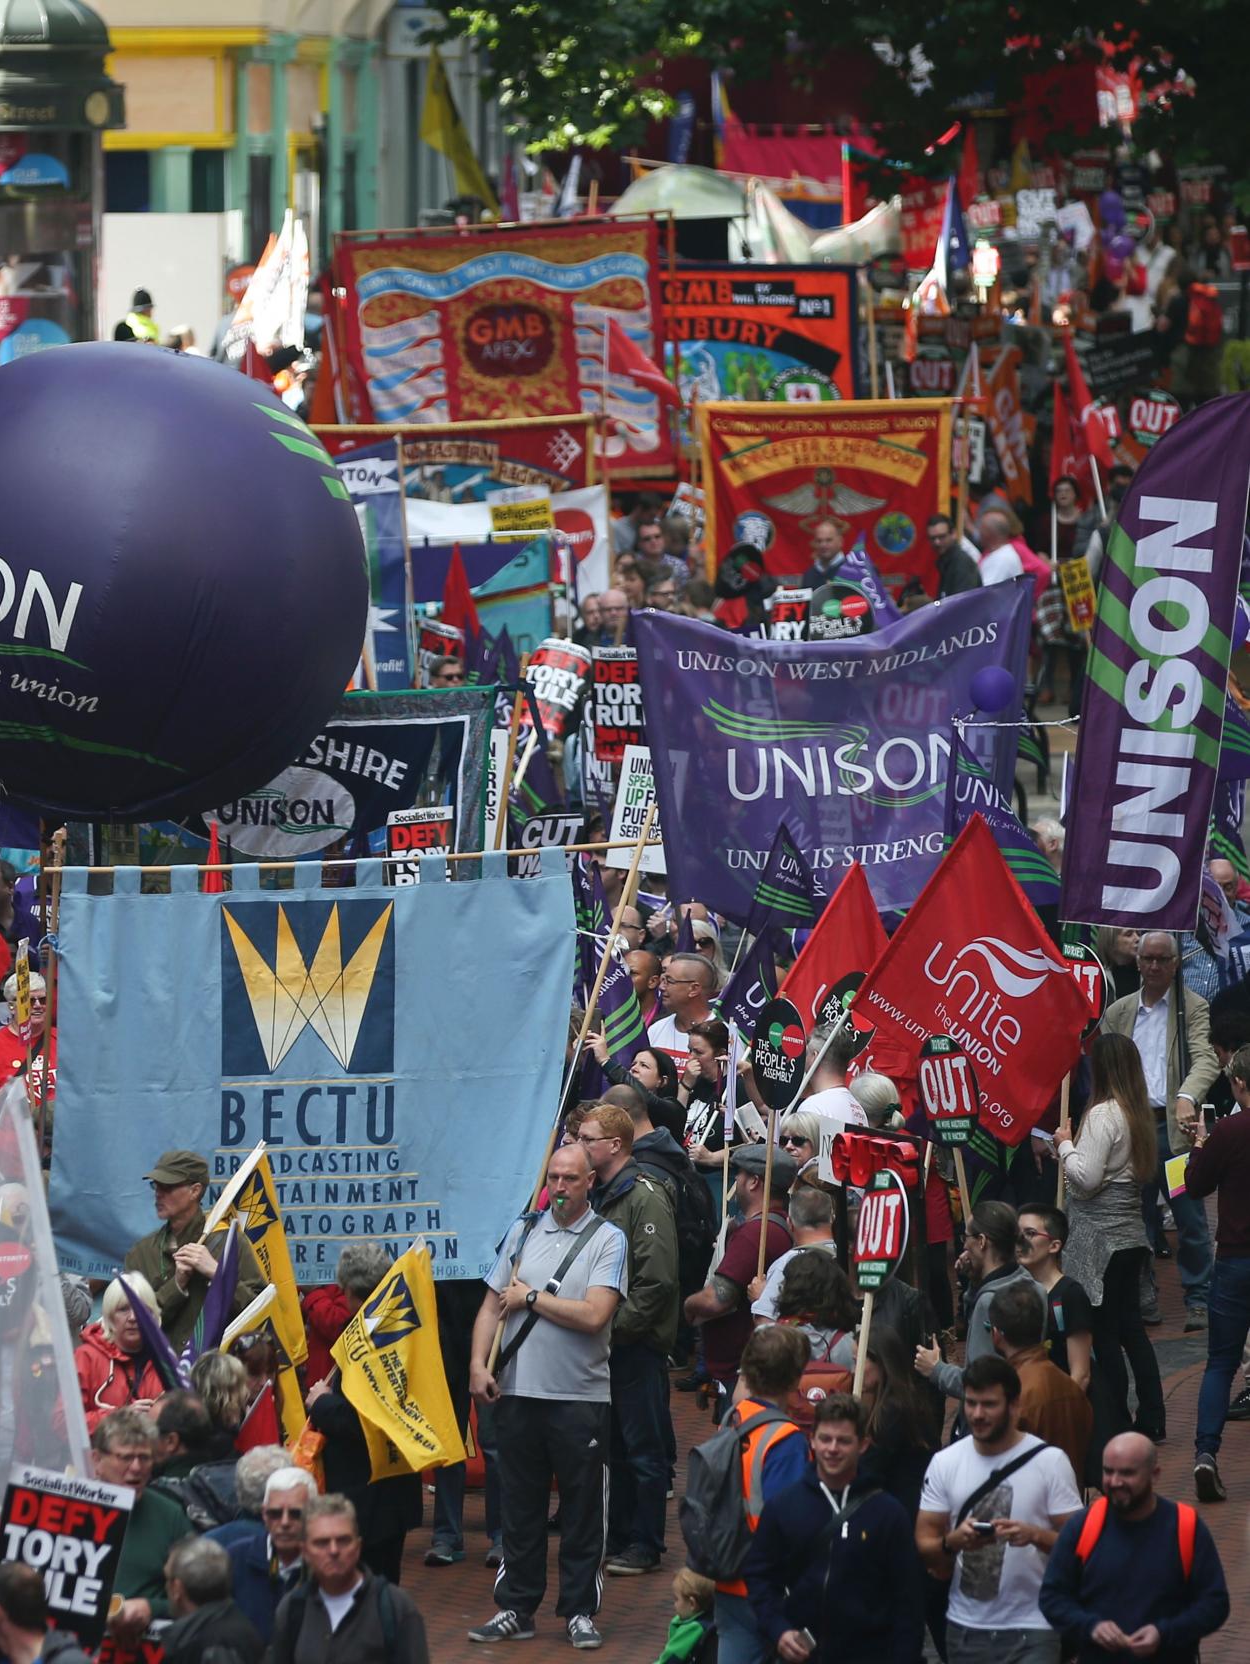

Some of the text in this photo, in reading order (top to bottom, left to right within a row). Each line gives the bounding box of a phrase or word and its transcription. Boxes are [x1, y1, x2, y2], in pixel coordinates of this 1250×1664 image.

[466, 257, 503, 275] WEST
[510, 259, 585, 281] MIDLANDS
[590, 256, 646, 276] REGION
[664, 281, 734, 305] GMB
[468, 312, 545, 345] GMB
[911, 363, 952, 388] OUT
[712, 417, 938, 433] COMMUNICATION WORKERS UNION
[1131, 397, 1179, 432] OUT
[729, 440, 928, 472] WORCESTER HEREFORD
[494, 503, 548, 521] Refugees
[676, 622, 999, 681] UNISON WEST MIDLANDS
[526, 664, 586, 693] TORY
[595, 662, 638, 682] DEF
[10, 669, 100, 714] union
[594, 683, 643, 705] TOR
[1101, 495, 1218, 914] UNISON
[297, 735, 409, 791] SHIRE
[625, 789, 645, 806] UP
[216, 798, 335, 826] UNISON
[394, 811, 426, 823] Socialist
[391, 821, 450, 849] DEFY
[521, 817, 585, 849] CUT
[811, 847, 835, 869] IS
[1063, 944, 1085, 958] TORIES
[830, 994, 842, 1008] THE
[923, 940, 1023, 1056] unite
[757, 1038, 770, 1051] THE
[762, 1066, 793, 1083] ASSEMBLY
[920, 1056, 972, 1115] OUT
[220, 1085, 395, 1146] BECTU
[214, 1151, 400, 1176] BRADCASTING
[857, 1194, 901, 1256] OUT
[61, 1257, 83, 1271] THIS
[298, 1270, 311, 1280] OF
[23, 1471, 118, 1503] Socialist Worker
[8, 1487, 121, 1544] DEFY
[2, 1522, 113, 1579] TORY
